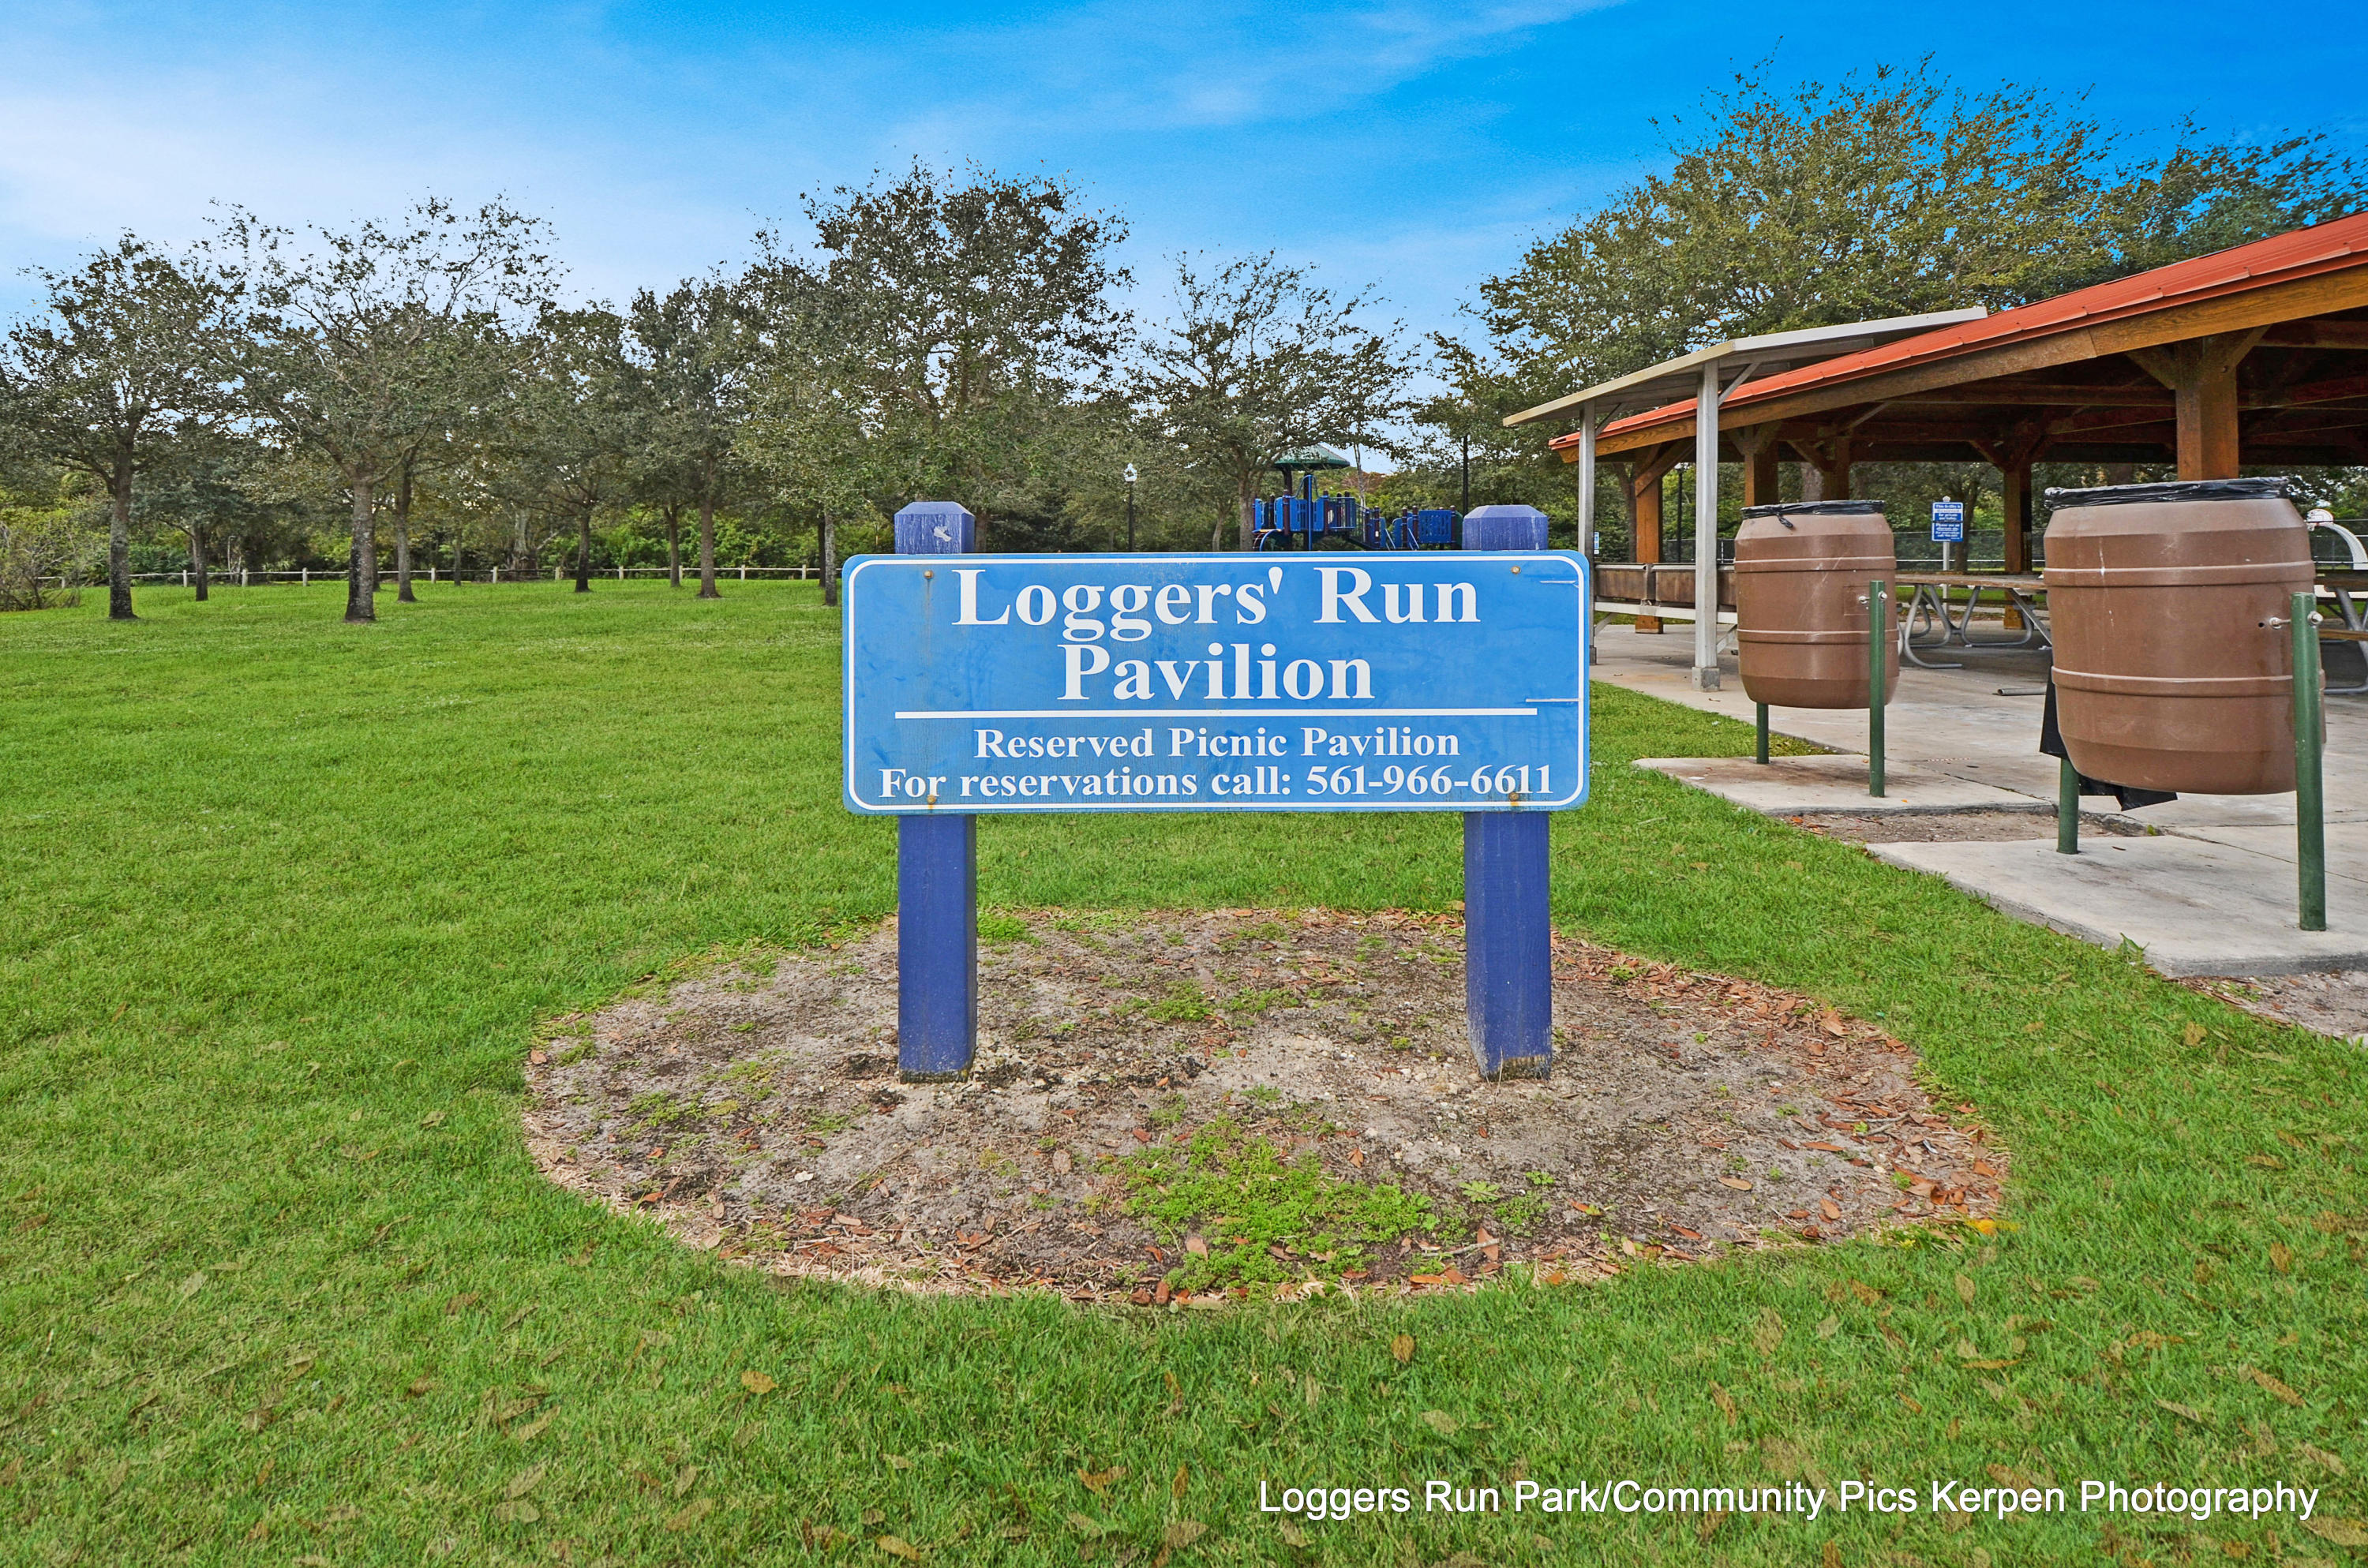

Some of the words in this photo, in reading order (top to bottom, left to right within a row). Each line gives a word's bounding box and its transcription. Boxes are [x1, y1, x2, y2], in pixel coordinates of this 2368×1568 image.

[951, 567, 1283, 642] Loggers'
[1313, 567, 1481, 623] Run
[1057, 642, 1375, 701] Pavilion
[974, 728, 1155, 758] Reserved
[1168, 727, 1287, 757] Picnic
[1301, 726, 1460, 756] Pavilion
[879, 769, 947, 798] For
[960, 767, 1197, 797] reservations
[1212, 765, 1291, 795] call:
[1306, 765, 1553, 795] 561-966-6611
